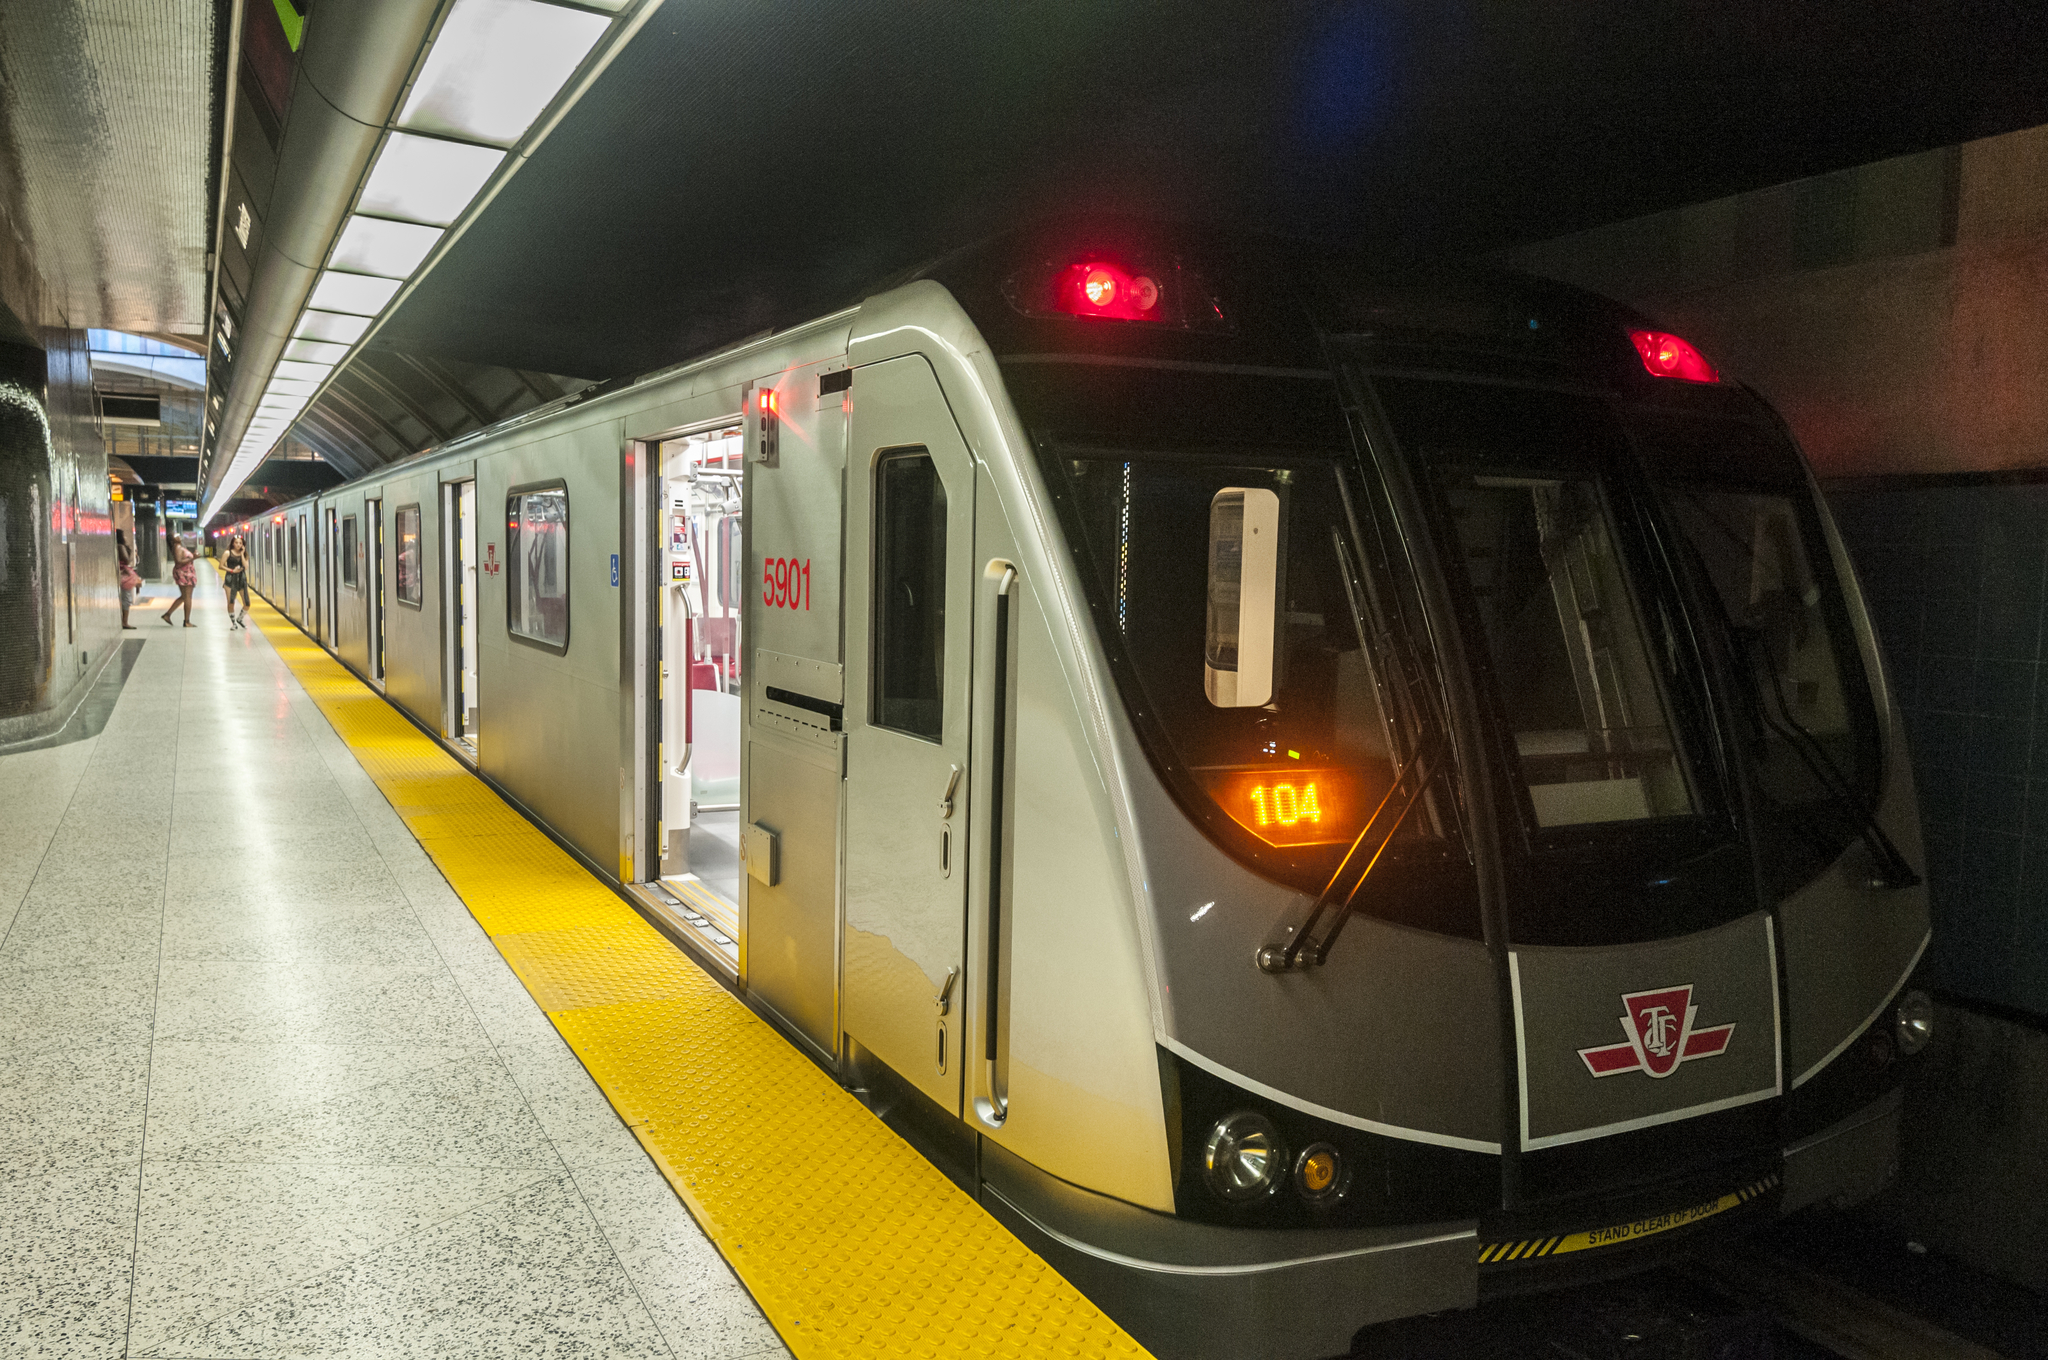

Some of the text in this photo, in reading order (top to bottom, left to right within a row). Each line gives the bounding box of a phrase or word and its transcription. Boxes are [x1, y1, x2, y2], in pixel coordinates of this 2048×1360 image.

[763, 557, 811, 611] 5901
[1250, 782, 1321, 826] 104
[1588, 1200, 1719, 1245] STAND CLEAR OF DOOR
